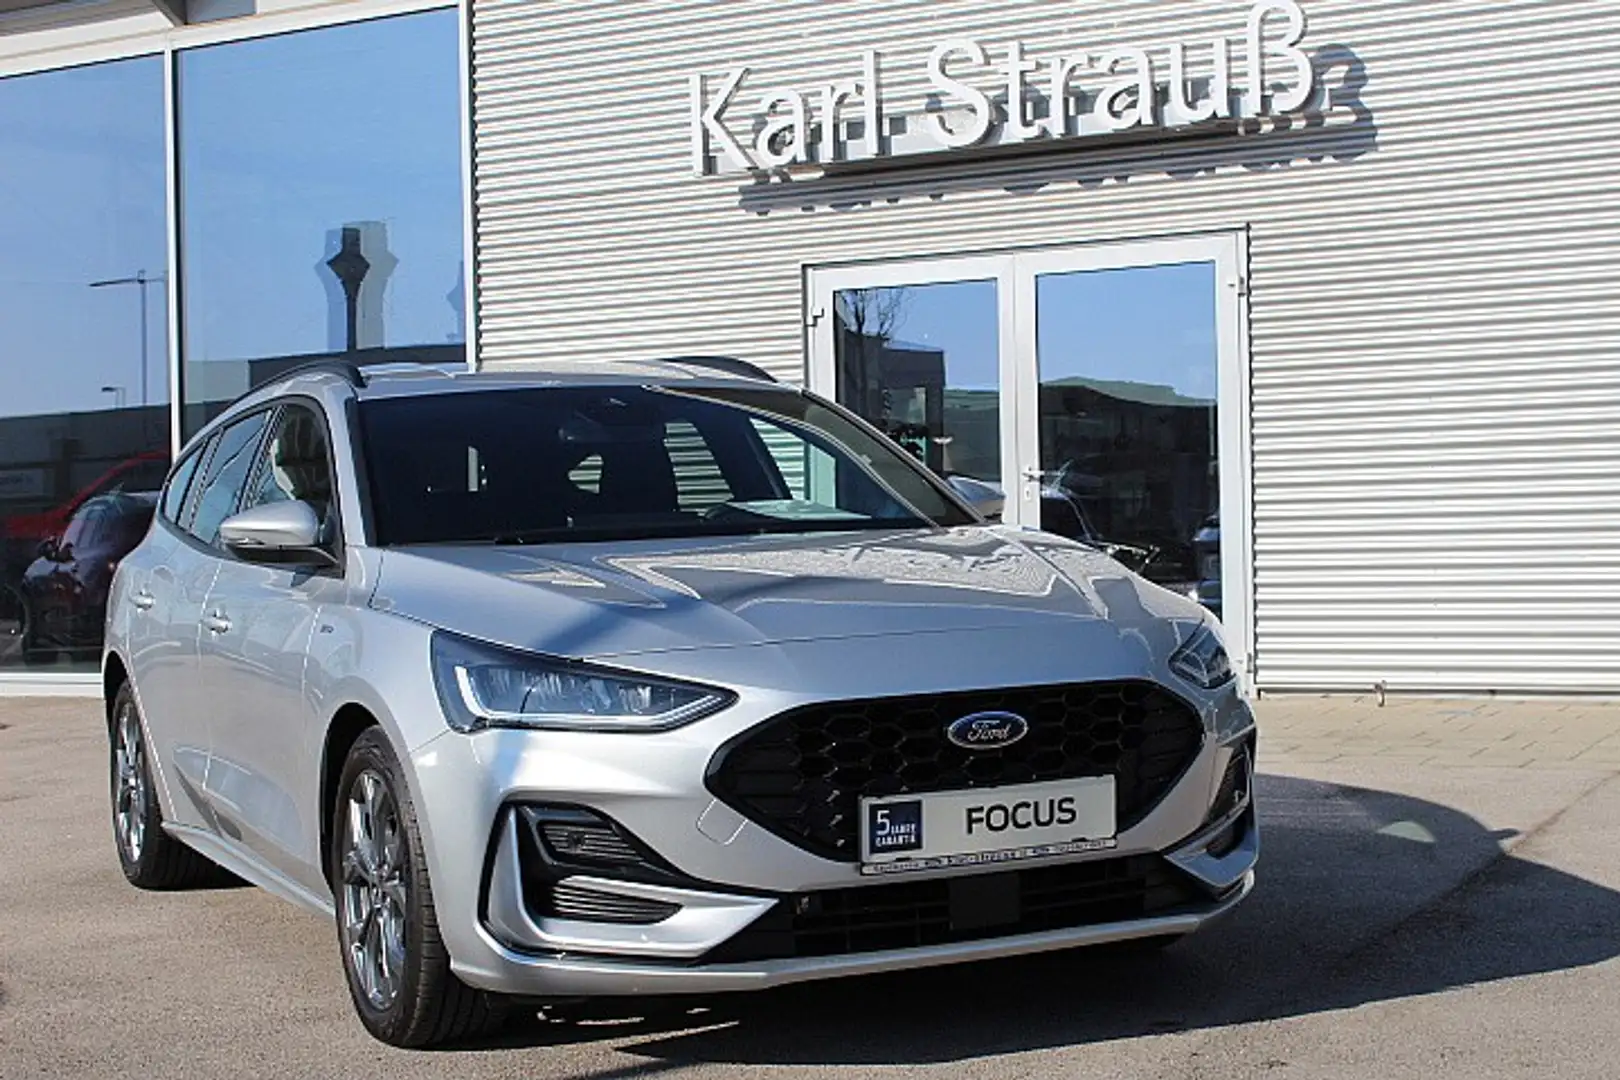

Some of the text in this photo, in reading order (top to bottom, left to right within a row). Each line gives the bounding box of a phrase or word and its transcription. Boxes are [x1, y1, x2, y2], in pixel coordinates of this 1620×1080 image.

[690, 0, 1314, 176] Karl Strauß
[967, 719, 1012, 742] Ford
[875, 809, 891, 836] 5
[965, 796, 1077, 835] FOCUS
